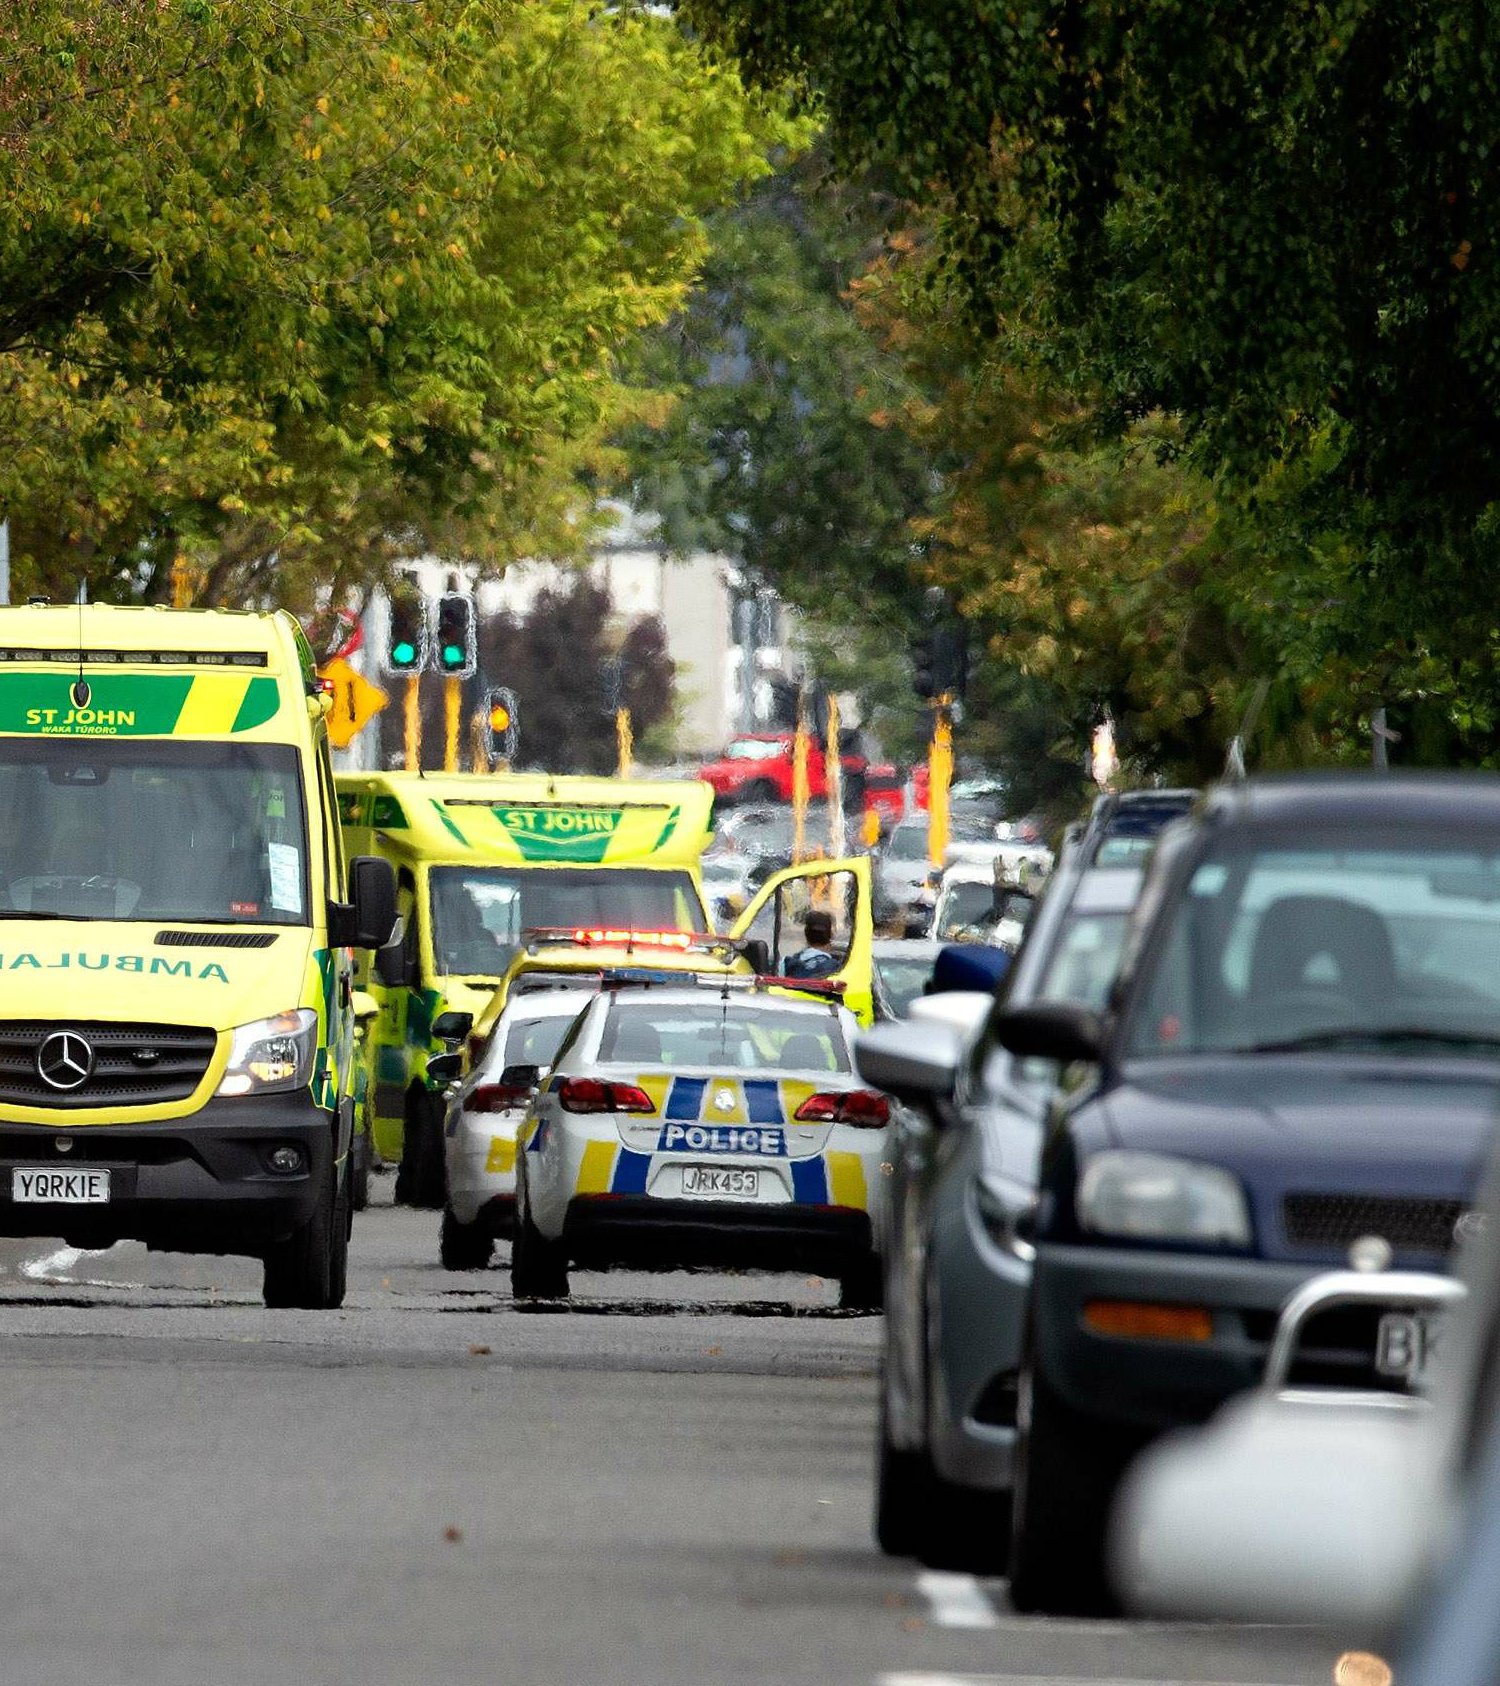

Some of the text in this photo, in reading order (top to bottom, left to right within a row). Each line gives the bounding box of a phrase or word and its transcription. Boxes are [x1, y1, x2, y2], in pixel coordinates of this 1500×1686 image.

[26, 708, 136, 726] ST JOHN
[41, 725, 72, 733] WAKA
[504, 811, 614, 833] ST JOHN
[665, 1124, 781, 1154] POLICE
[20, 1174, 101, 1198] YQRKIE
[684, 1172, 757, 1194] JRK453
